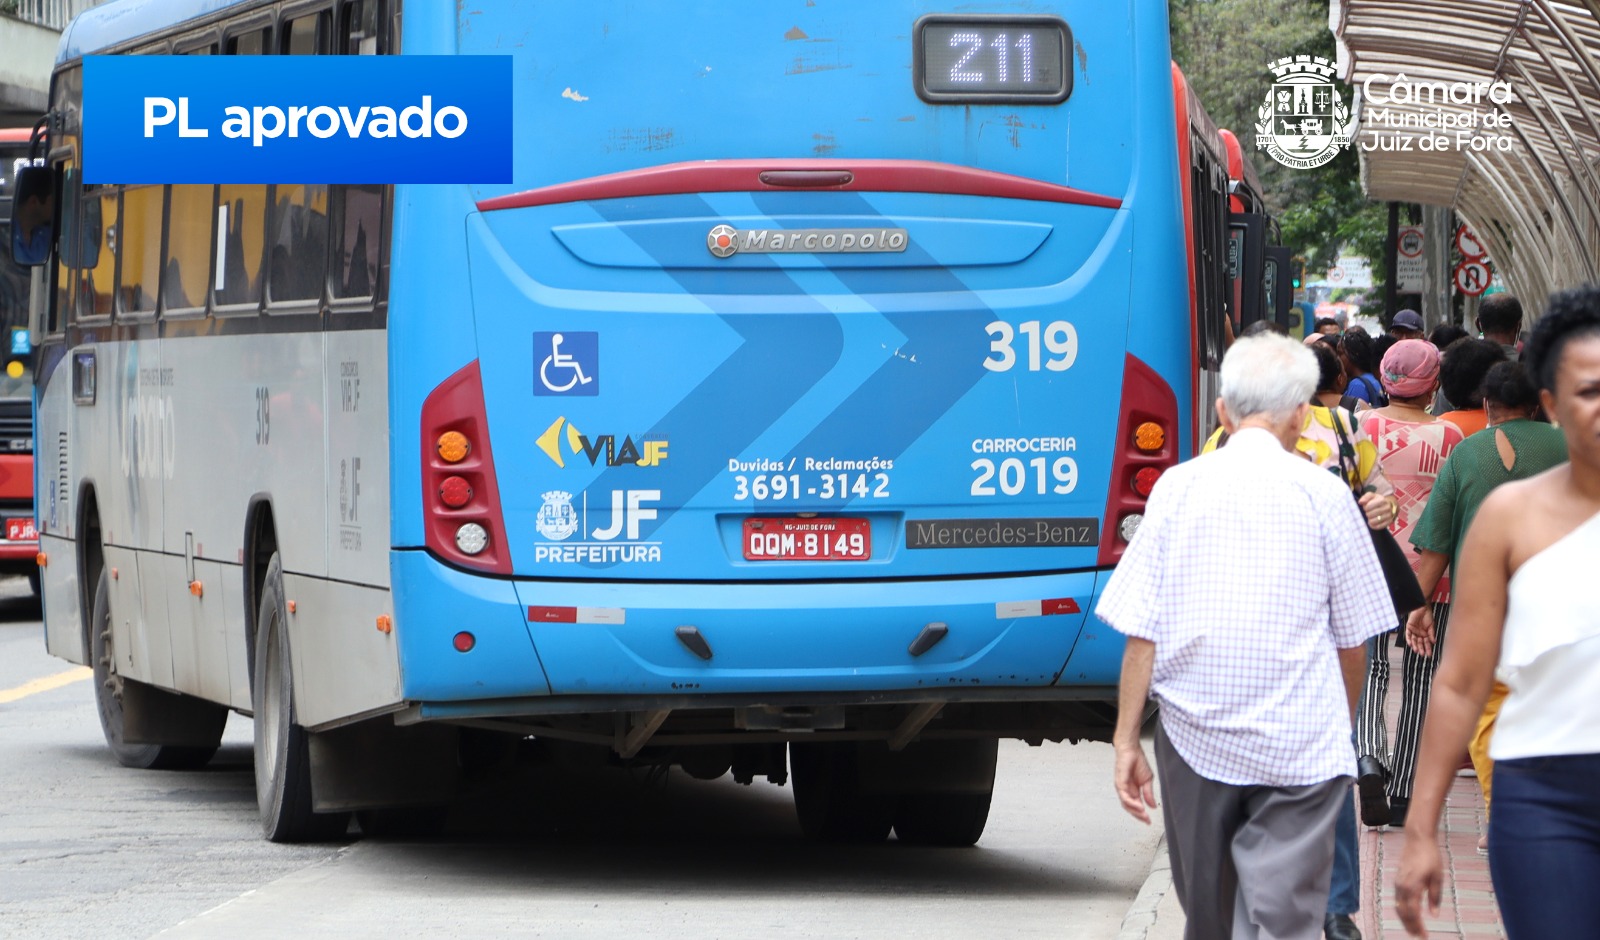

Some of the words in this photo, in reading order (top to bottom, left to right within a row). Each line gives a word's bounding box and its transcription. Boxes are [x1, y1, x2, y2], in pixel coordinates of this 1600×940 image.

[949, 33, 1032, 82] 211
[744, 230, 904, 251] Marcopolo
[982, 320, 1078, 373] 319
[256, 386, 270, 446] 319
[971, 437, 1076, 453] CARROCERIA
[728, 458, 784, 472] Duvidas
[805, 456, 893, 473] Reclamações
[970, 456, 1078, 497] 2019
[349, 456, 361, 522] JF
[733, 473, 890, 500] 3691-3142
[591, 489, 661, 541] JF
[915, 522, 1090, 546] Mercedes-Benz
[535, 546, 661, 563] PREFEITURA
